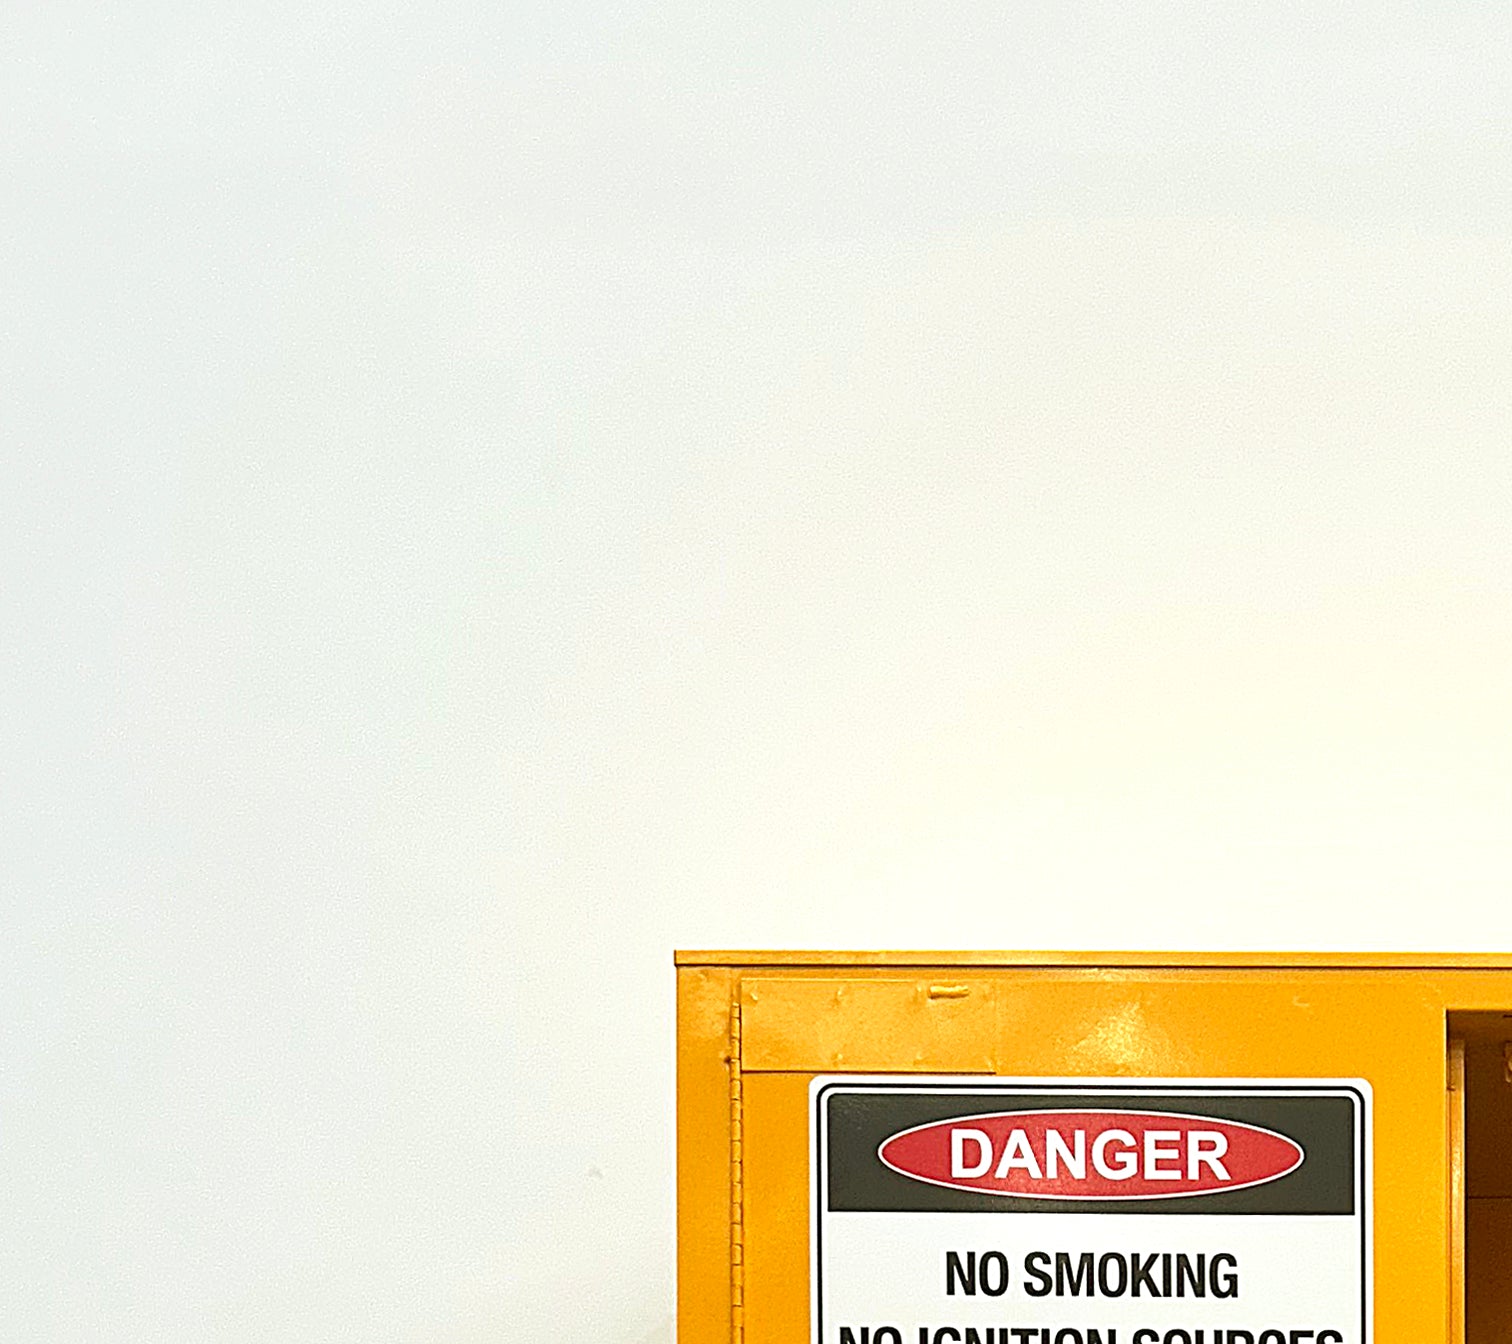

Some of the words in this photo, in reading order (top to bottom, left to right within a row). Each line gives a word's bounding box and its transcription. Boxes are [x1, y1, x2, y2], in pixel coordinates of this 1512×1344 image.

[952, 1129, 1230, 1180] DANGER
[946, 1251, 1008, 1296] NO
[1024, 1252, 1238, 1298] SMOKING
